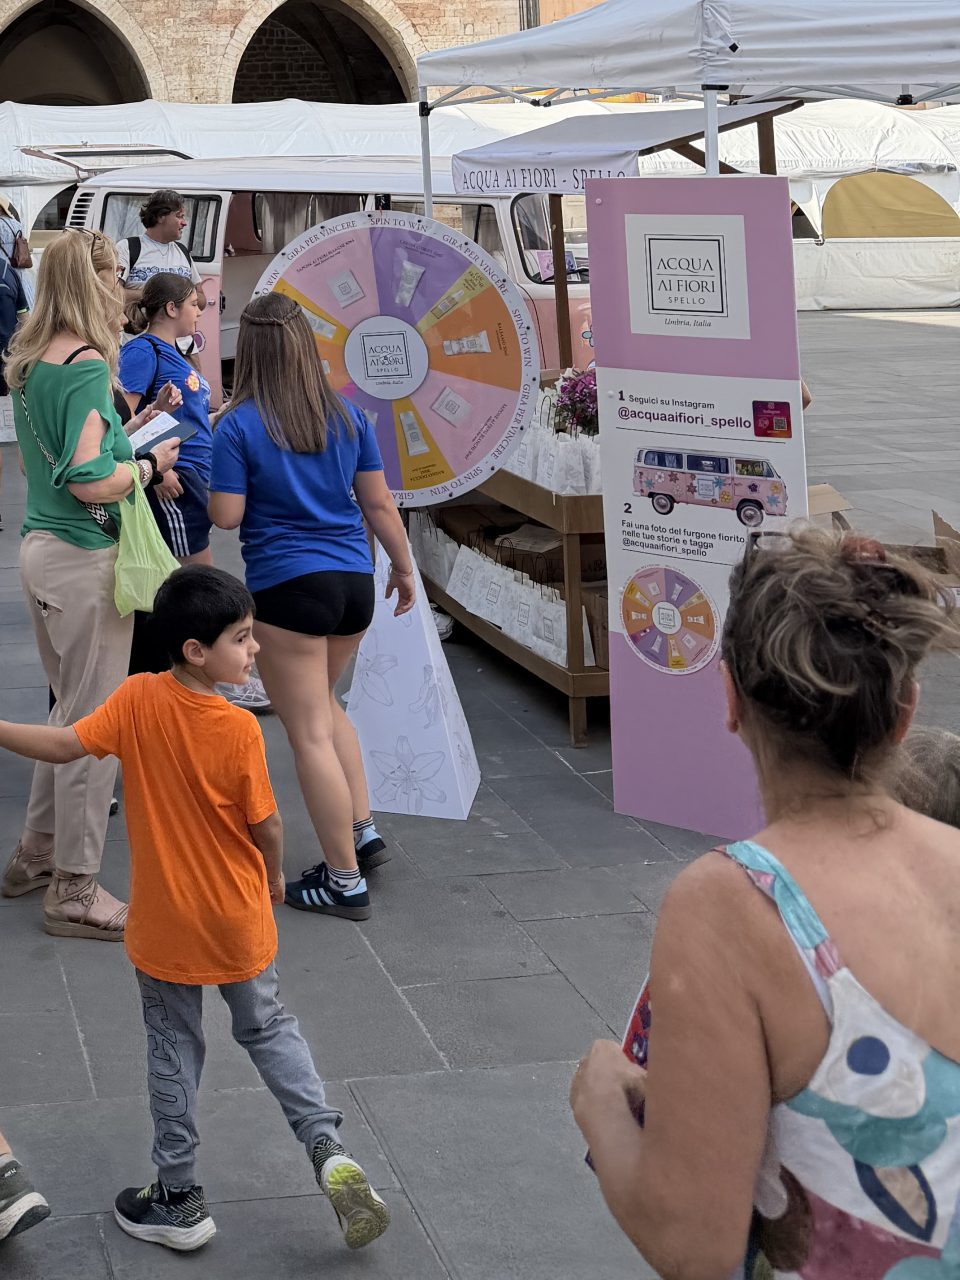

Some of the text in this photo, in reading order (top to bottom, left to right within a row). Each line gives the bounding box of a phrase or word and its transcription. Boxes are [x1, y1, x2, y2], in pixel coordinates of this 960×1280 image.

[463, 170, 500, 192] ACQUA
[505, 169, 517, 188] AI
[522, 168, 557, 188] FIORI
[370, 218, 428, 232] SPIN TO WIN
[287, 245, 306, 261] GIRA
[304, 234, 320, 247] PER
[320, 220, 357, 237] VINCERE
[442, 234, 463, 250] GIRA
[464, 248, 480, 264] PER
[480, 260, 509, 296] VINCERE
[656, 257, 714, 274] ACQUA
[267, 271, 280, 286] WIN
[657, 279, 715, 293] AI FIORI
[668, 296, 706, 305] SPELLO
[664, 318, 692, 327] Umbria,
[511, 308, 532, 367] SPIN TO WIN
[369, 345, 402, 354] ACQUA
[618, 390, 715, 410] 1 Seguici su Instagram
[491, 383, 531, 461] GIRA PER VINCERE
[618, 406, 752, 429] @acquaaifiori_spello
[430, 466, 483, 497] SPIN TO WIN
[391, 491, 415, 500] GIRA
[623, 502, 632, 514] 2
[621, 519, 745, 543] Fai una foto del furgone fiorito
[622, 529, 641, 539] nelle
[642, 532, 655, 541] tue
[656, 534, 680, 544] storie
[689, 538, 714, 550] tagga
